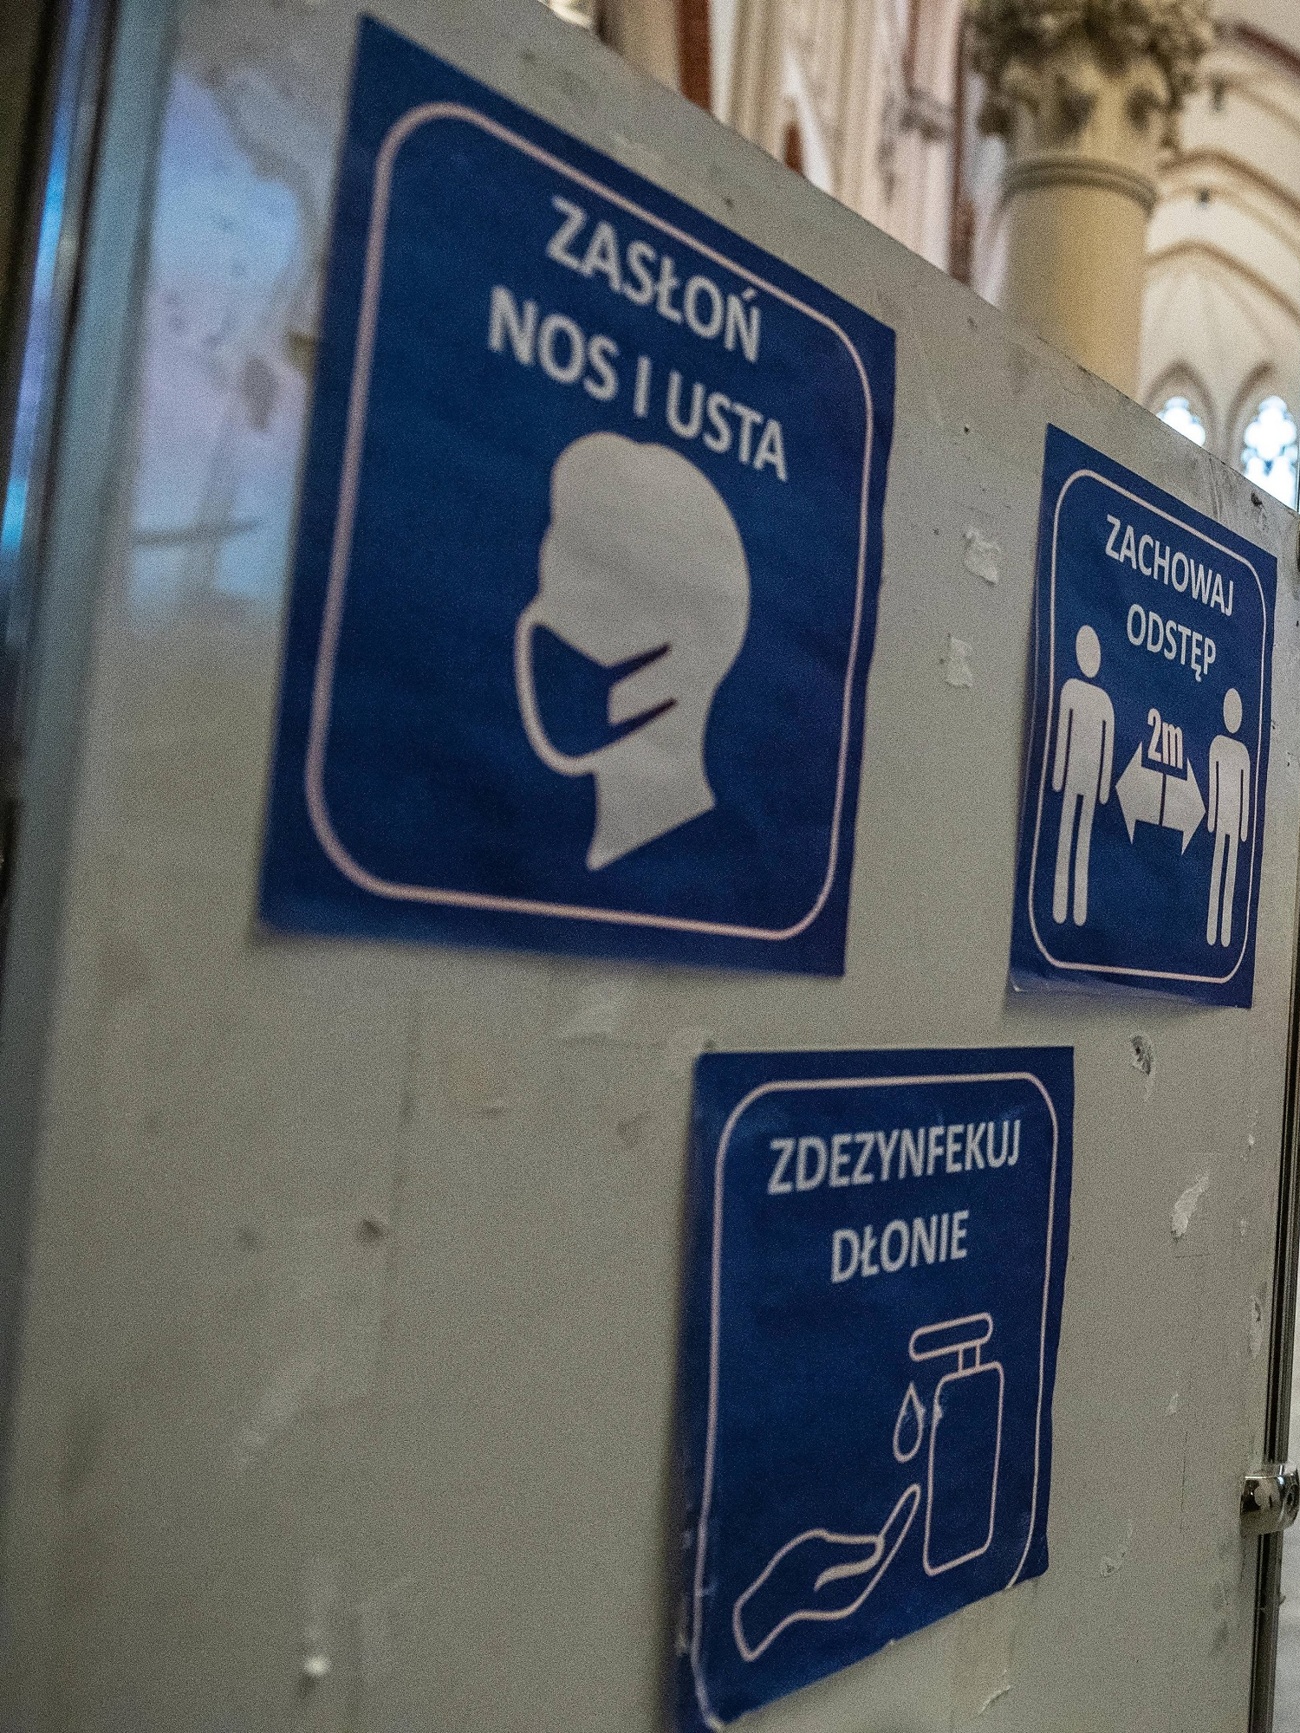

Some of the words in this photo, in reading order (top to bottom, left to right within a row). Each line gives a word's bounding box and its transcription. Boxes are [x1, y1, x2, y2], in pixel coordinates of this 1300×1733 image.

[545, 195, 761, 363] ZASŁOŃ
[488, 285, 620, 401] NOS
[632, 355, 651, 418] I
[666, 370, 788, 482] USTA
[1104, 514, 1234, 617] ZACHOWAJ
[1126, 604, 1216, 682] ODSTĘP
[1147, 708, 1184, 769] 2m
[767, 1119, 1021, 1195] ZDEZYNFEKUJ
[831, 1209, 969, 1284] DŁONIE
